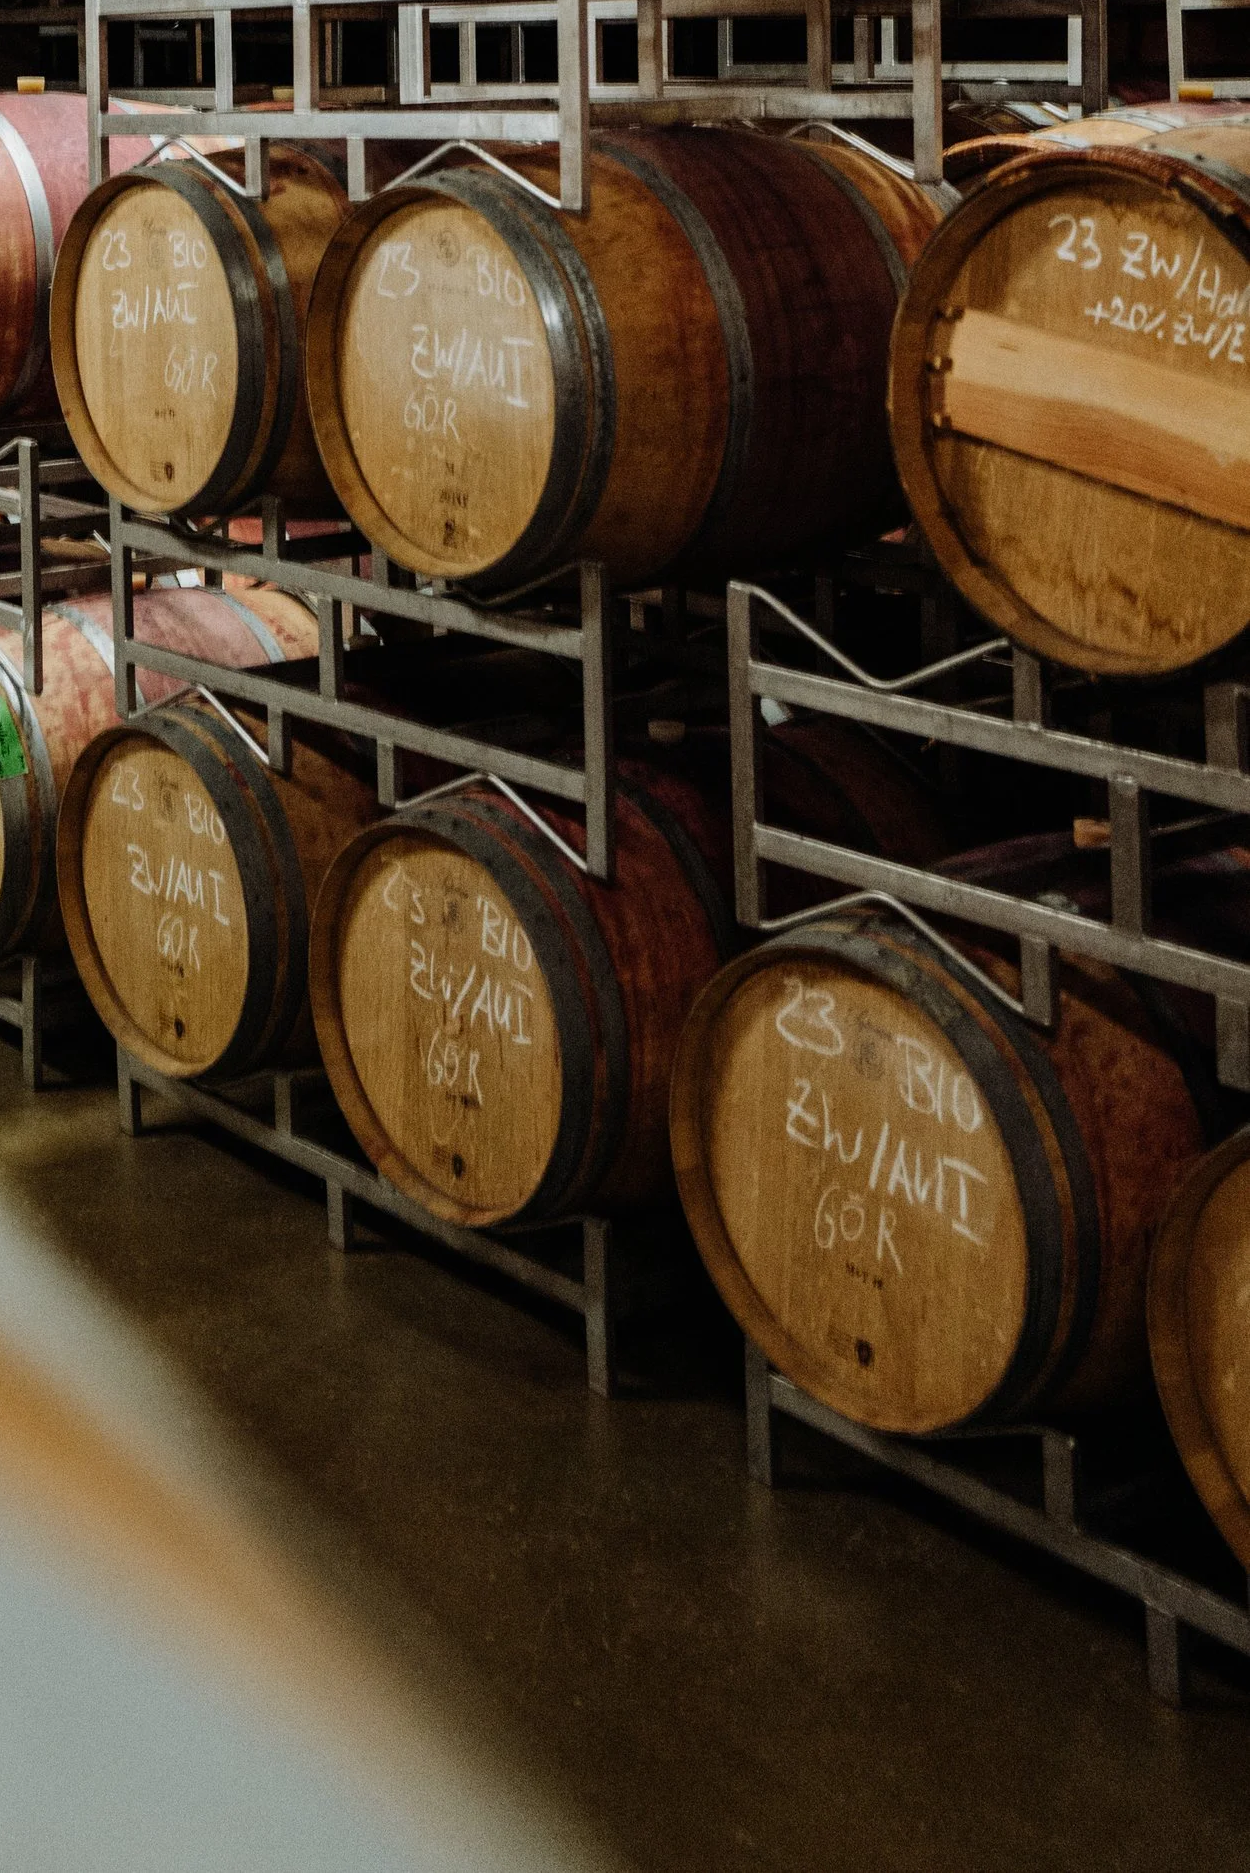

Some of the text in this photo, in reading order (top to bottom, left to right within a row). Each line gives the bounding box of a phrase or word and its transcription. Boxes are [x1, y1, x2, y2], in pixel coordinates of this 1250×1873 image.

[100, 228, 208, 271] 23 BIO
[377, 240, 527, 307] 23 BIO
[1047, 213, 1102, 270] 23
[110, 761, 226, 845] 23 BIO
[476, 894, 532, 972] BIO
[775, 973, 985, 1133] 23 BIO
